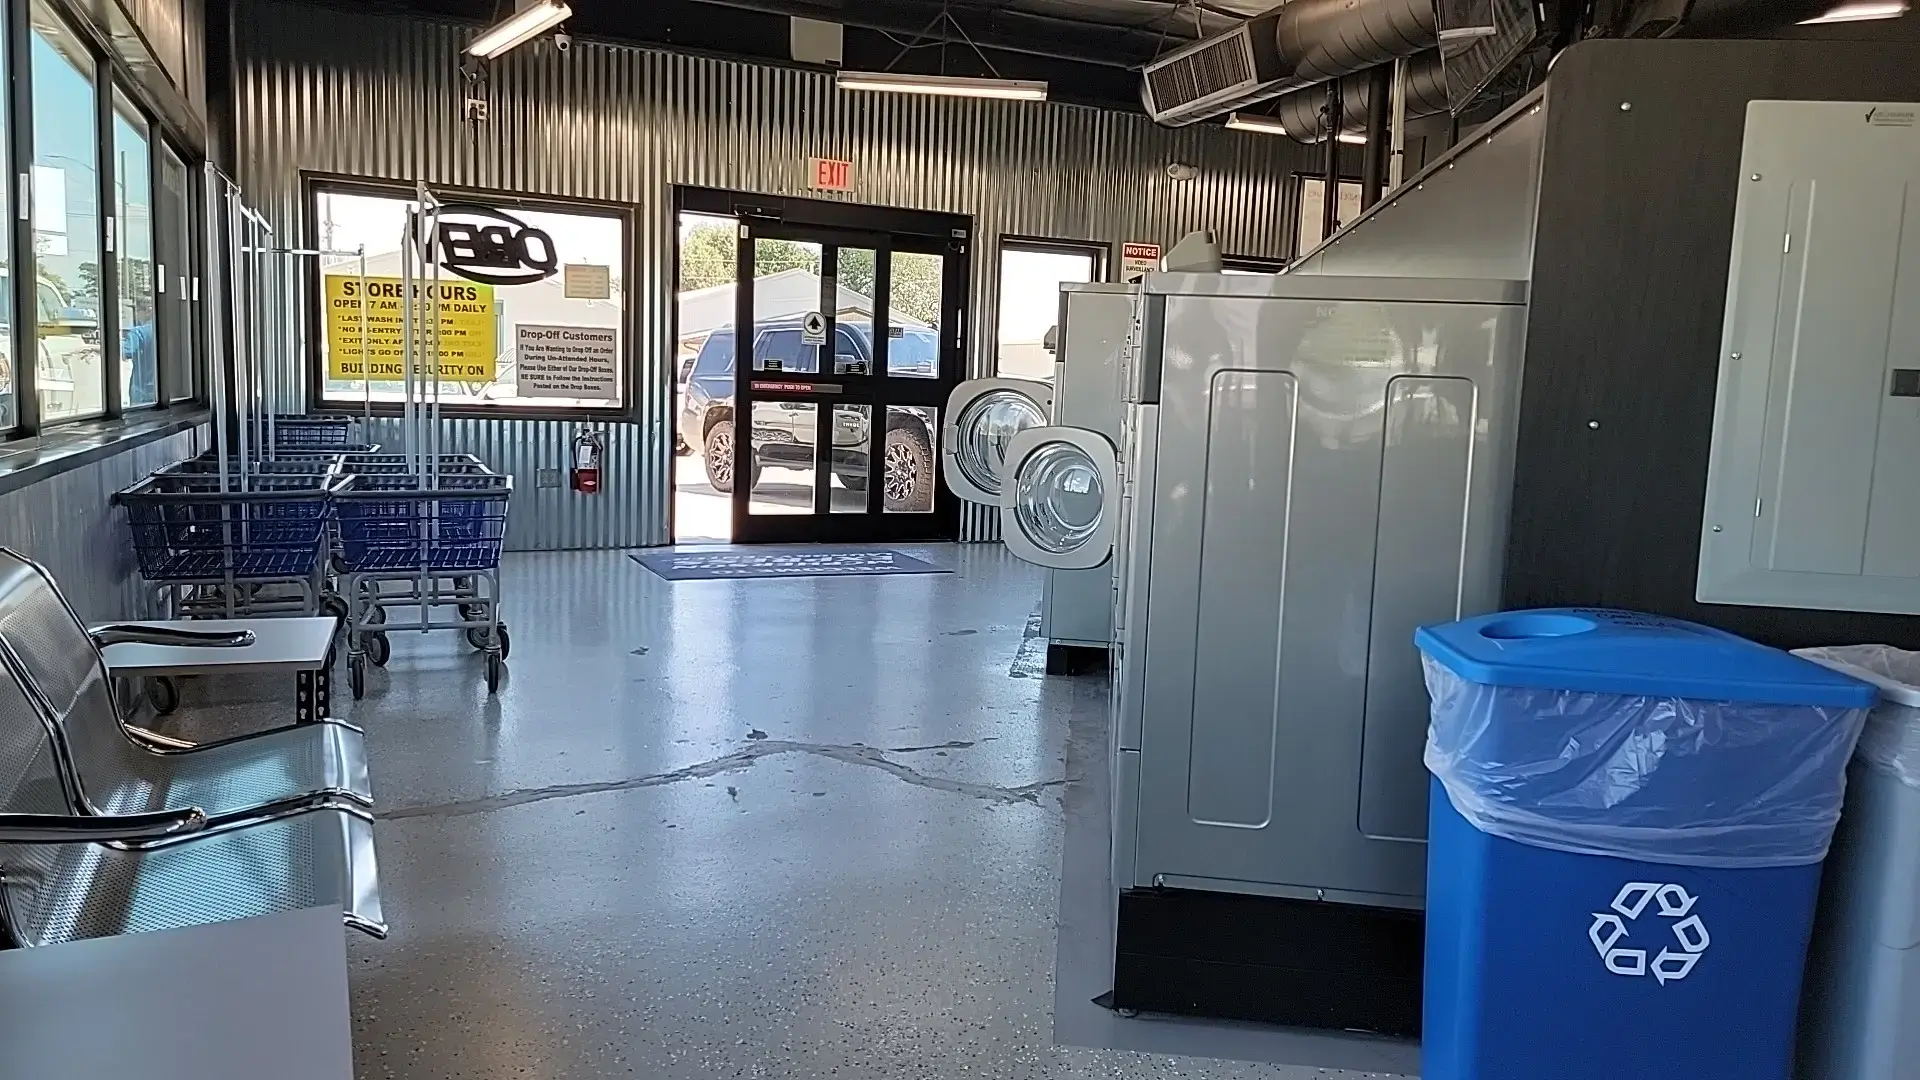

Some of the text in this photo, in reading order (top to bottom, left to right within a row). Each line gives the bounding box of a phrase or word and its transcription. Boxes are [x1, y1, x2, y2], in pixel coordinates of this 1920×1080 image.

[818, 160, 849, 189] EXIT
[1125, 246, 1157, 257] NOTICE
[369, 300, 376, 309] 7
[380, 301, 398, 310] AM
[453, 304, 487, 313] DAILY
[521, 329, 613, 342] Drop-Off Customers
[525, 344, 535, 352] You
[546, 345, 565, 354] Wanting
[573, 346, 584, 354] Drop
[600, 347, 614, 355] Order
[525, 353, 545, 362] During
[548, 354, 587, 363] Un-Attended
[467, 365, 485, 376] ON
[520, 363, 536, 371] Please
[548, 364, 562, 372] Either
[578, 365, 597, 374] Drop-Off
